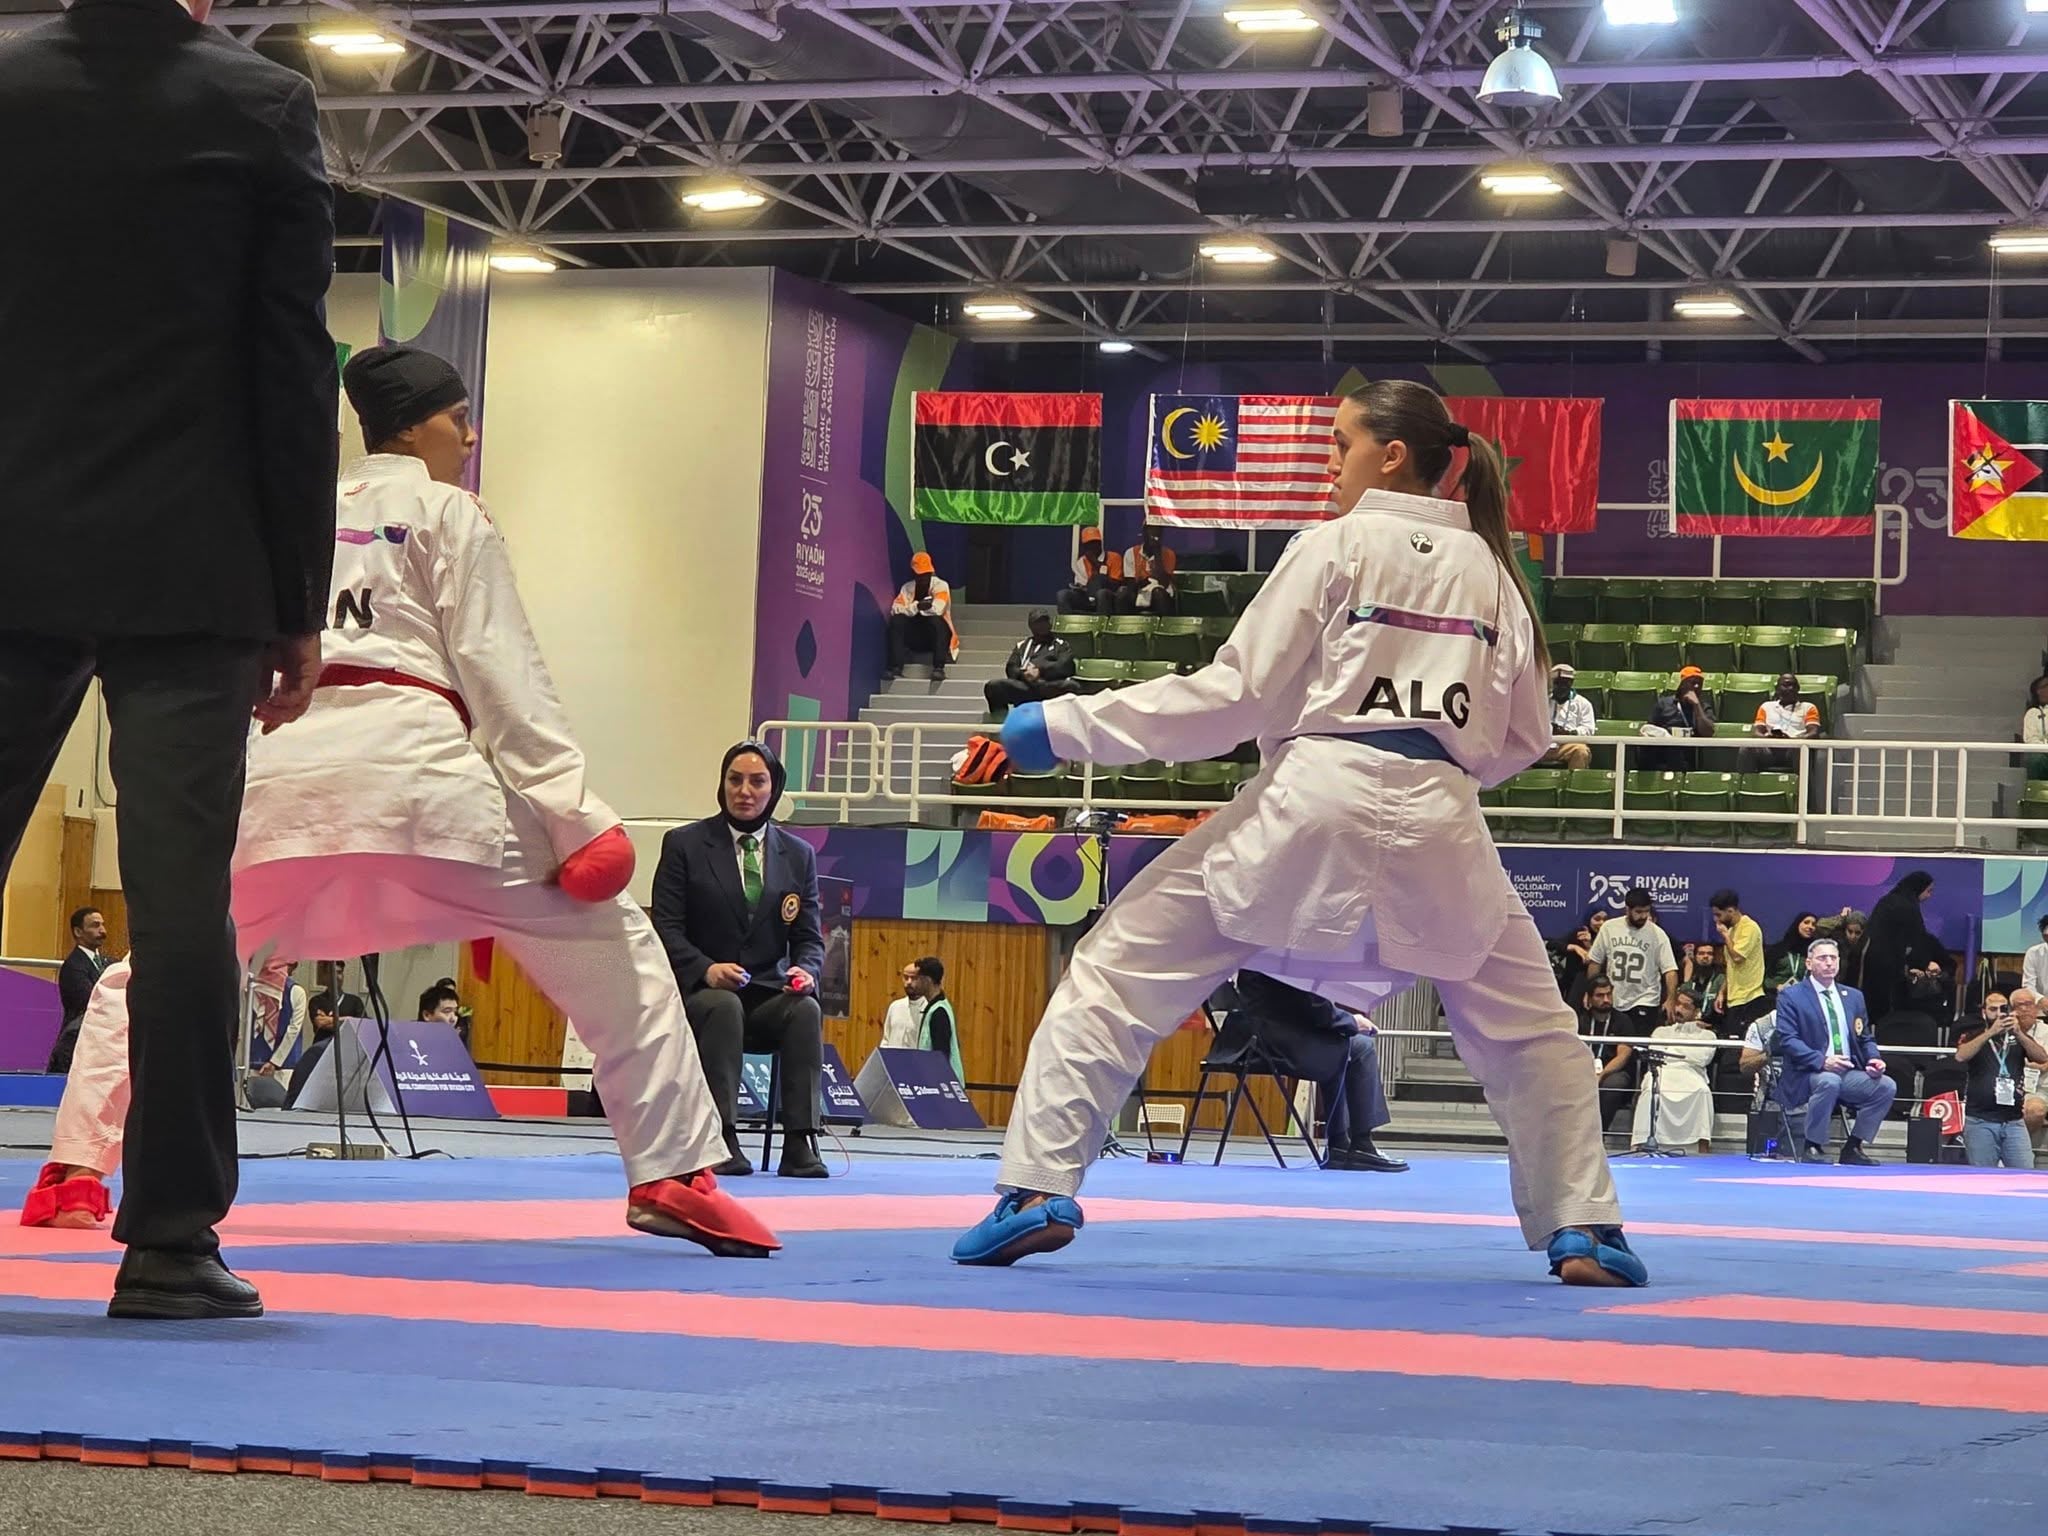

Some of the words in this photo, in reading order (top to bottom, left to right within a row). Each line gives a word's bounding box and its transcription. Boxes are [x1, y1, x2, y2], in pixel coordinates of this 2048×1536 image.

[820, 320, 831, 408] SOLIDARITY
[826, 317, 838, 414] ASSOCIATION
[817, 414, 827, 471] ISLAMIC
[823, 417, 832, 473] SPORTS
[796, 543, 824, 566] RIYADH
[1355, 675, 1471, 729] ALG
[1514, 874, 1545, 883] ISLAMIC
[1635, 874, 1690, 891] RIYADH
[1518, 891, 1544, 899] PORTS
[1523, 900, 1567, 908] SOCIATION
[1659, 891, 1689, 904] الرياض
[1611, 936, 1650, 952] DALLAS
[1611, 950, 1646, 984] 32
